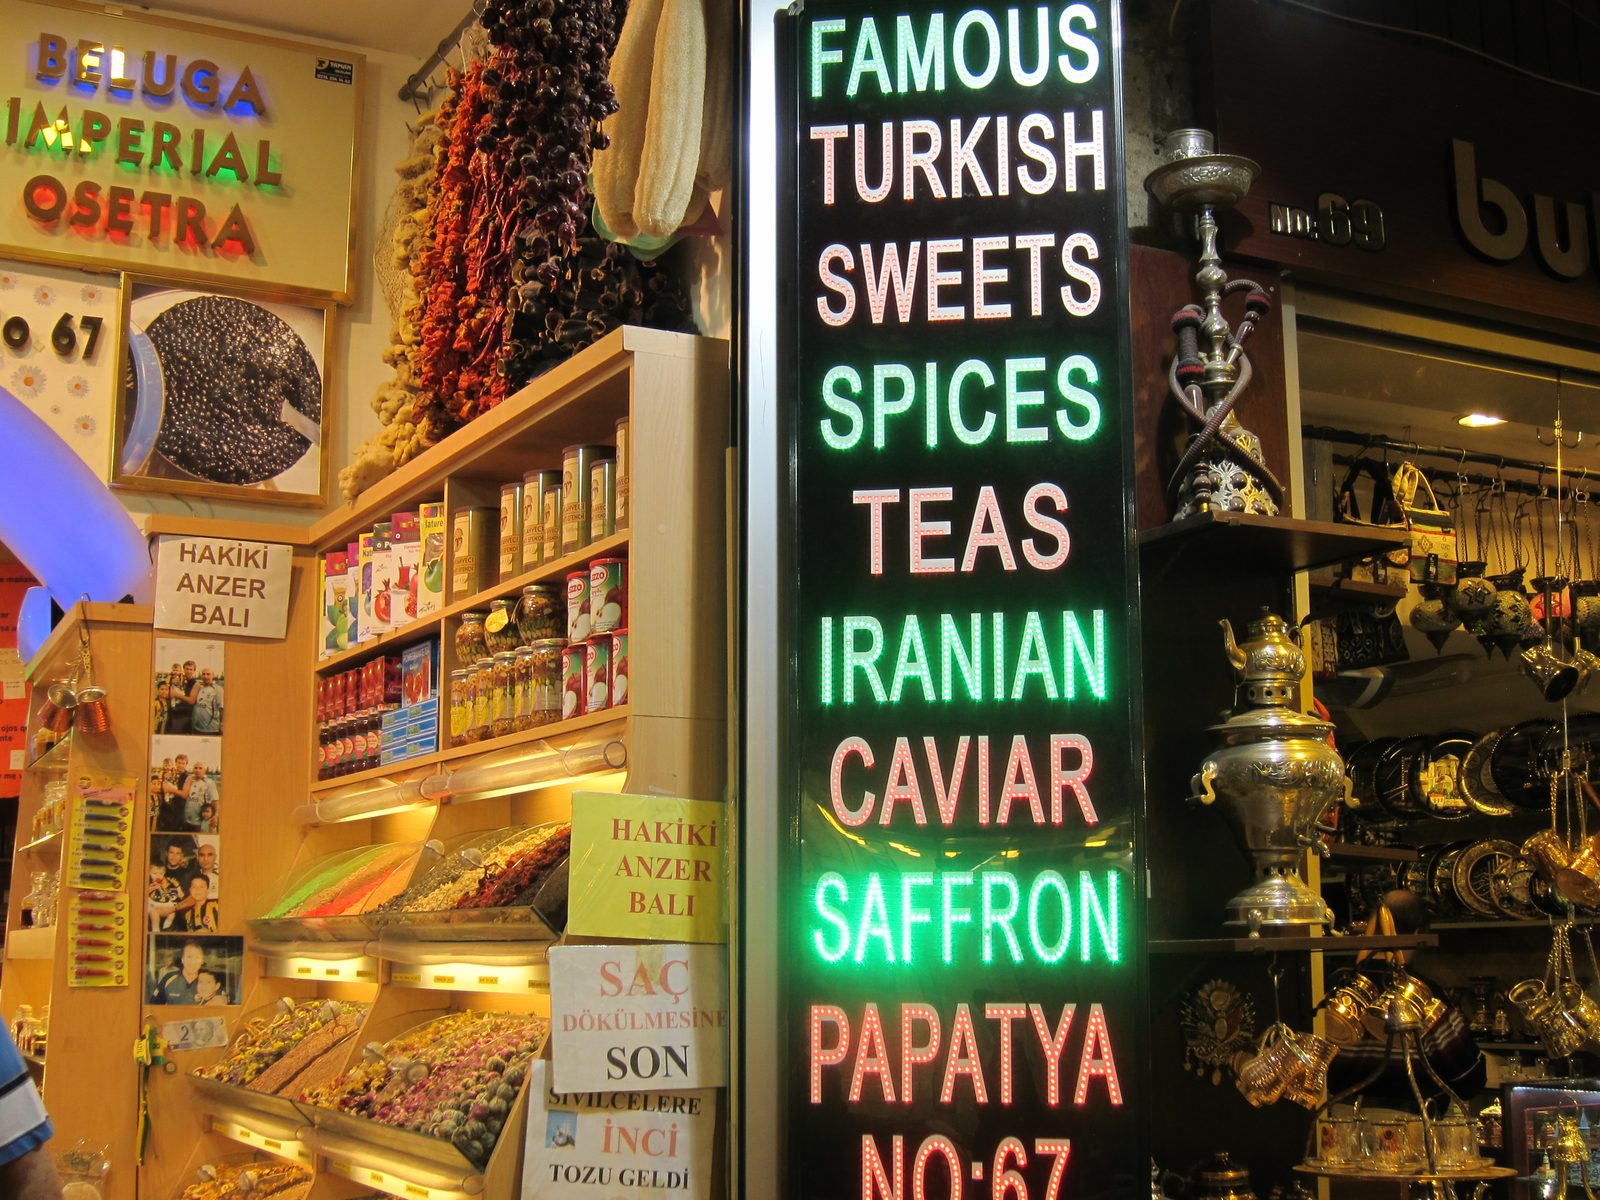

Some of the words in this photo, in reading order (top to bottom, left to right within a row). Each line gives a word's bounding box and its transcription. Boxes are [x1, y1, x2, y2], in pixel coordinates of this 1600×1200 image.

[37, 33, 266, 116] BELUGA
[811, 4, 1100, 97] FAMOUS
[6, 97, 282, 186] IMPERIAL
[810, 110, 1105, 205] TURKISH
[24, 175, 255, 256] OSETRA
[1453, 138, 1600, 279] bu
[817, 232, 1101, 326] SWEETS
[0, 312, 30, 348] O
[51, 312, 103, 359] 67
[820, 355, 1101, 450] SPICES
[180, 542, 269, 569] HAKİKİ
[853, 482, 1071, 575] TEAS
[176, 573, 266, 600] ANZER
[190, 604, 250, 628] BALI
[821, 609, 1104, 703] IRANIAN
[830, 733, 1098, 826] CAVIAR
[610, 817, 718, 848] HAKİKİ
[615, 855, 713, 882] ANZER
[629, 891, 697, 917] BALI
[813, 869, 1120, 963] SAFFRON
[562, 1007, 727, 1033] DÖKÜLMESİNE
[600, 959, 690, 1004] SAÇ
[606, 1045, 690, 1080] SON
[810, 1003, 1123, 1104] PAPATYA
[549, 1164, 612, 1187] TOZU
[618, 1167, 690, 1190] GELDİ
[602, 1118, 680, 1158] İNCİ
